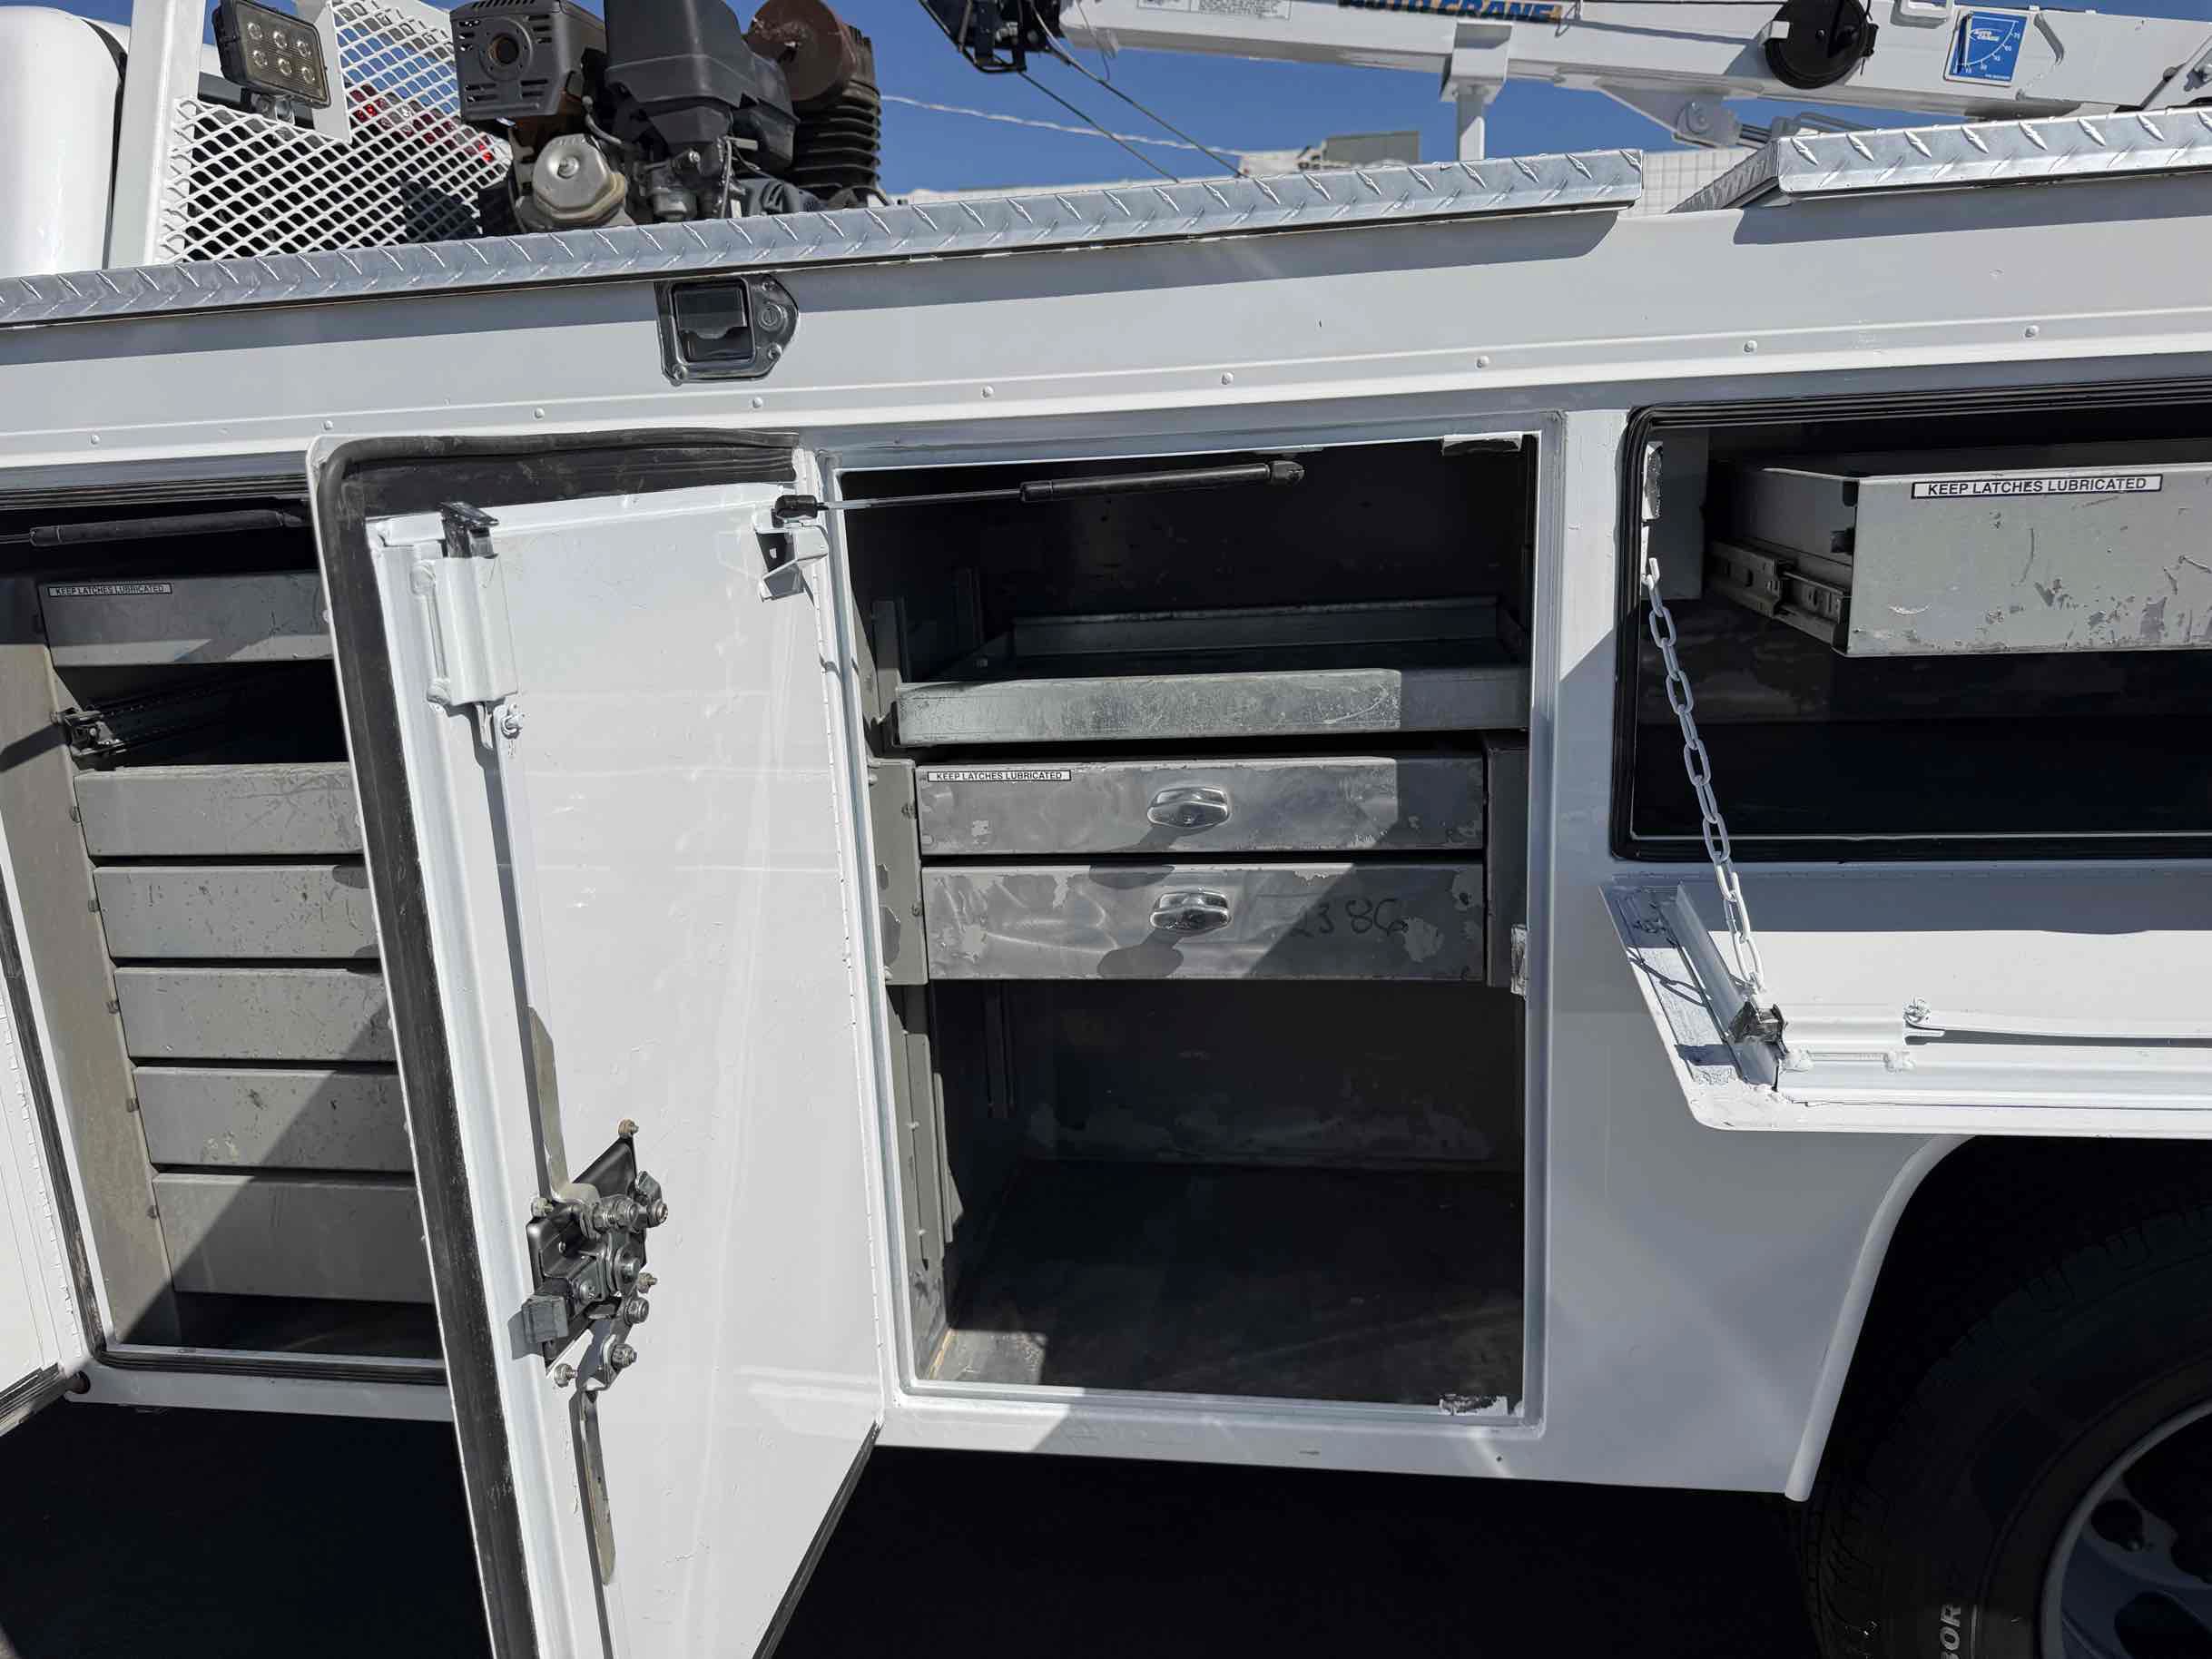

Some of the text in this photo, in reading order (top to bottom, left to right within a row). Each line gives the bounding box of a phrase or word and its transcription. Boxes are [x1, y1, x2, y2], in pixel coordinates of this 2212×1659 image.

[1436, 0, 1556, 22] CRANE
[1928, 477, 2147, 496] KEEP LATCHES LUBRICATED
[56, 587, 76, 596] KEEP
[936, 771, 1062, 780] KEEP LATCHES LUBRICATED
[1939, 1604, 1961, 1659] OR
